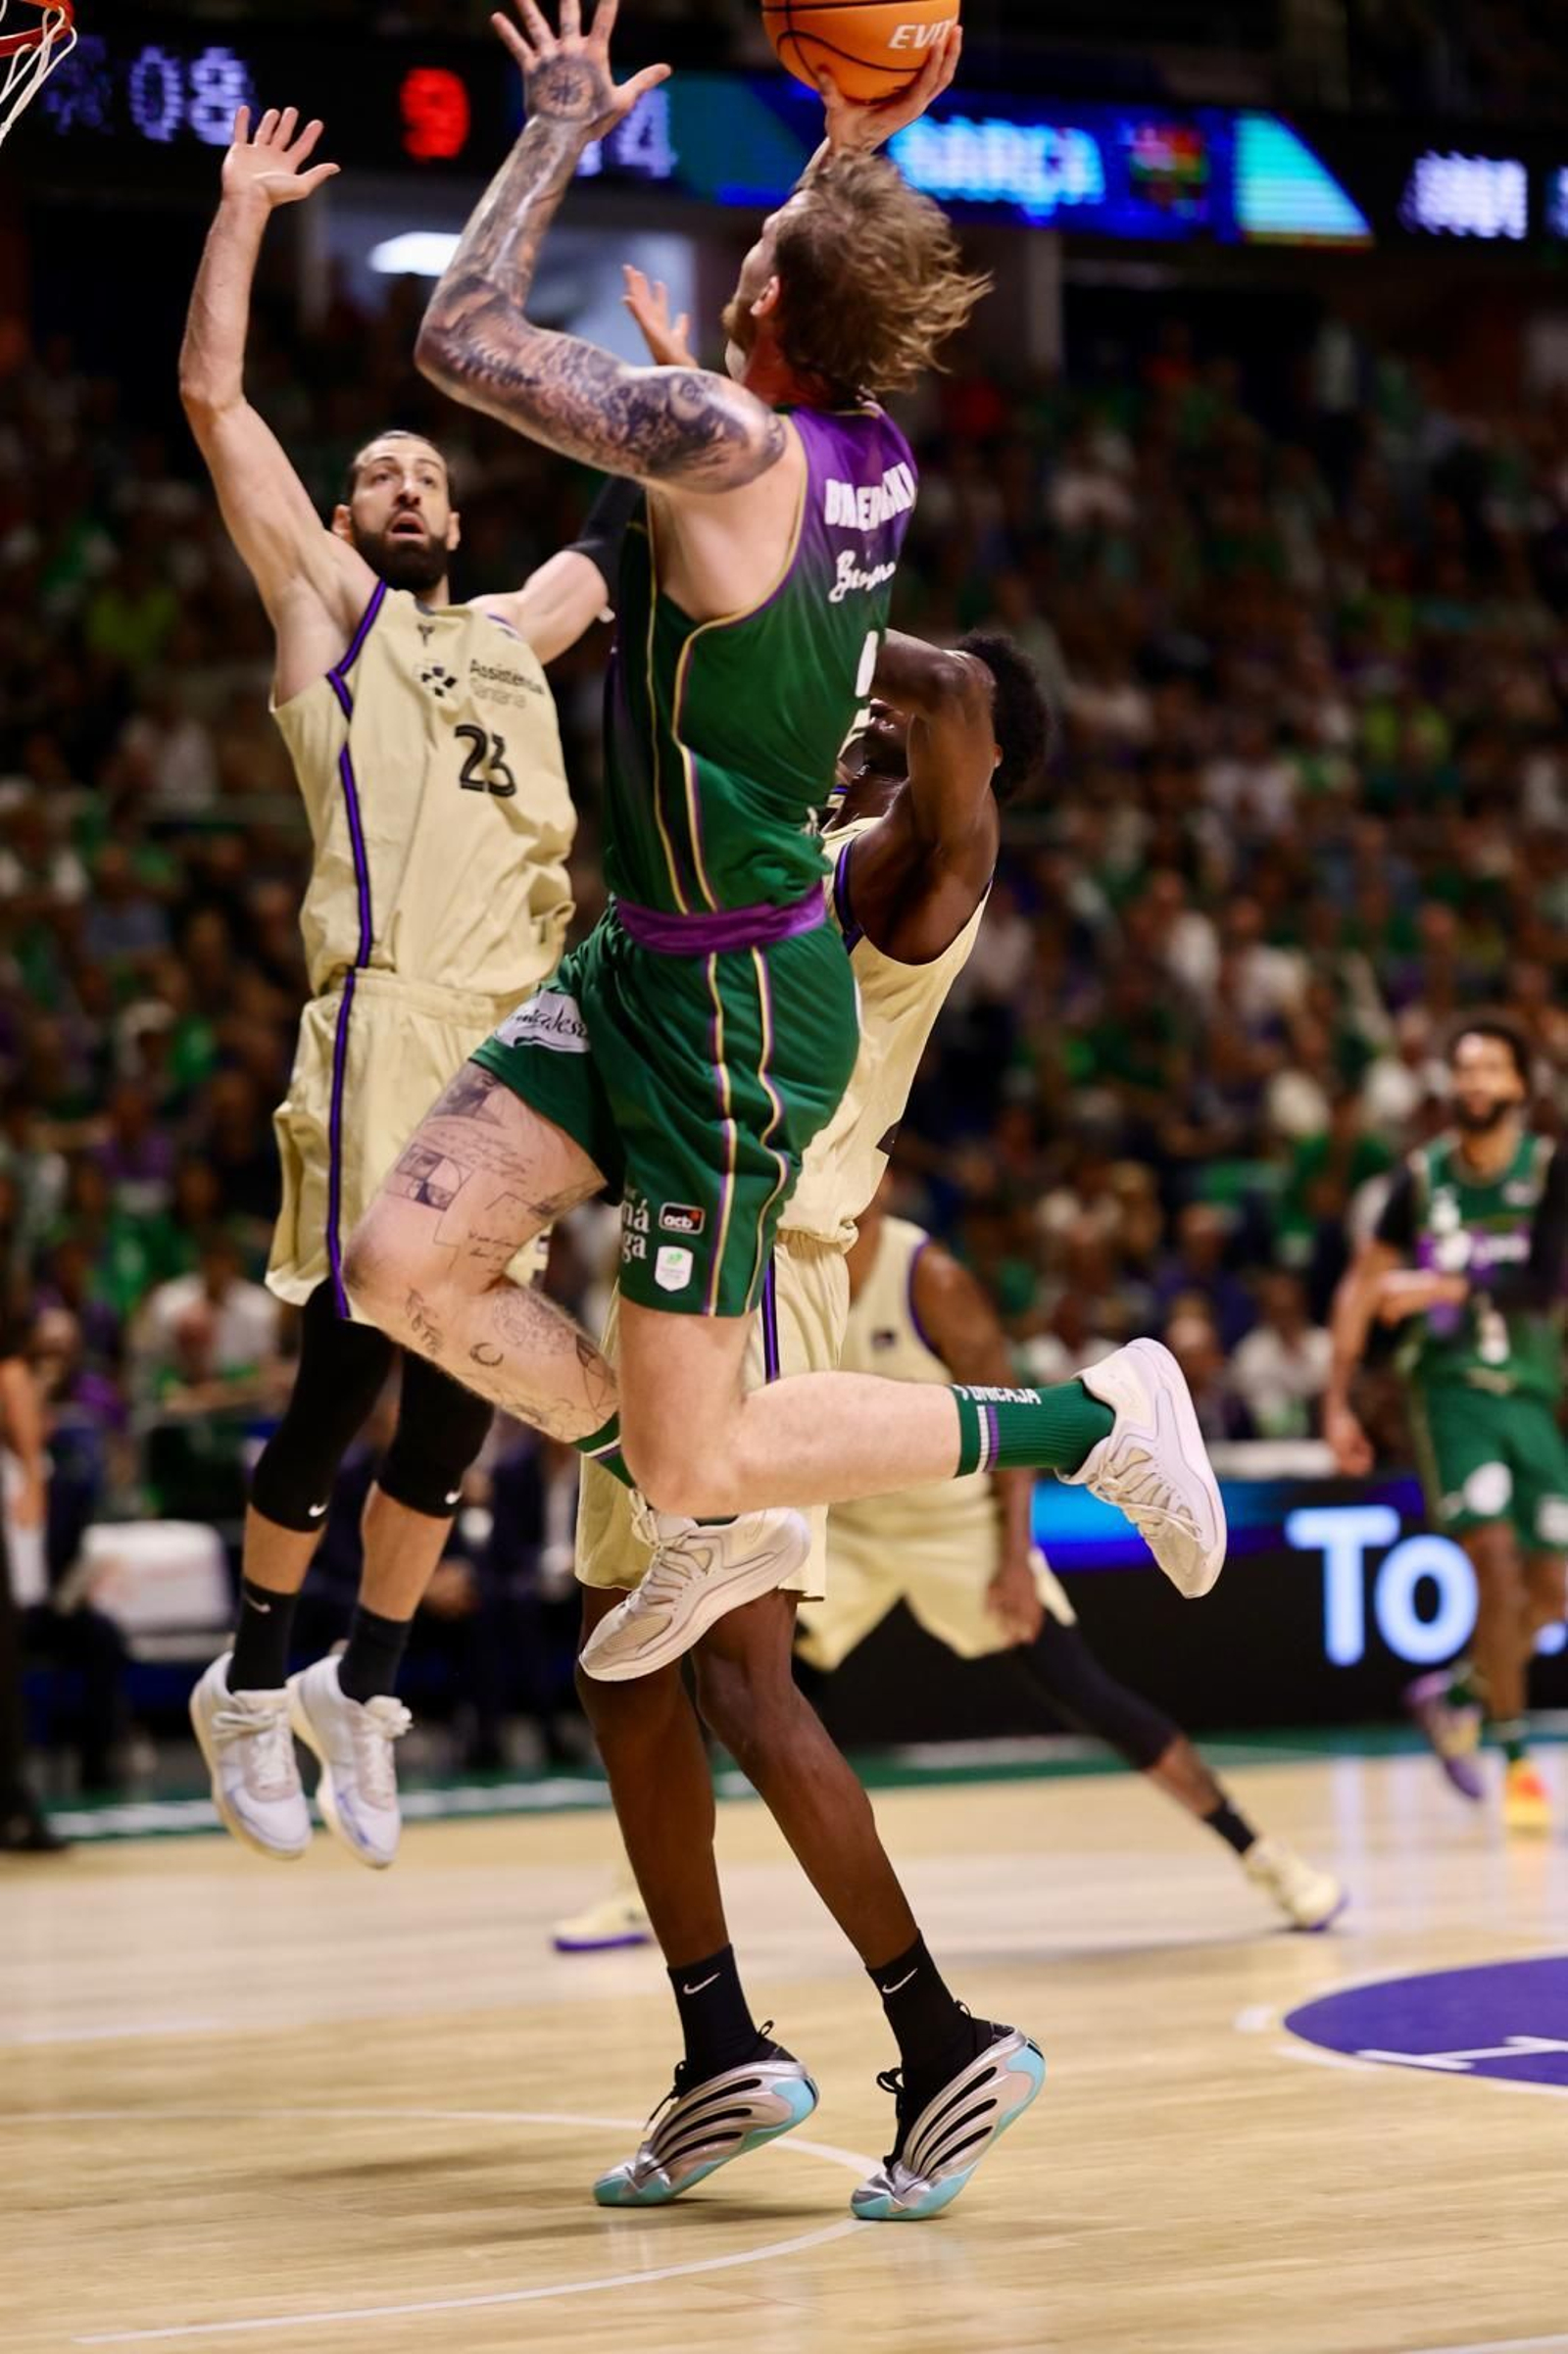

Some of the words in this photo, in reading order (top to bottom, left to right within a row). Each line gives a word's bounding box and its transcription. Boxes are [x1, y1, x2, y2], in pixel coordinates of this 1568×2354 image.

[128, 45, 247, 146] 08
[399, 67, 470, 159] 9
[454, 723, 517, 798] 23
[966, 1385, 1042, 1405] UNICAJA
